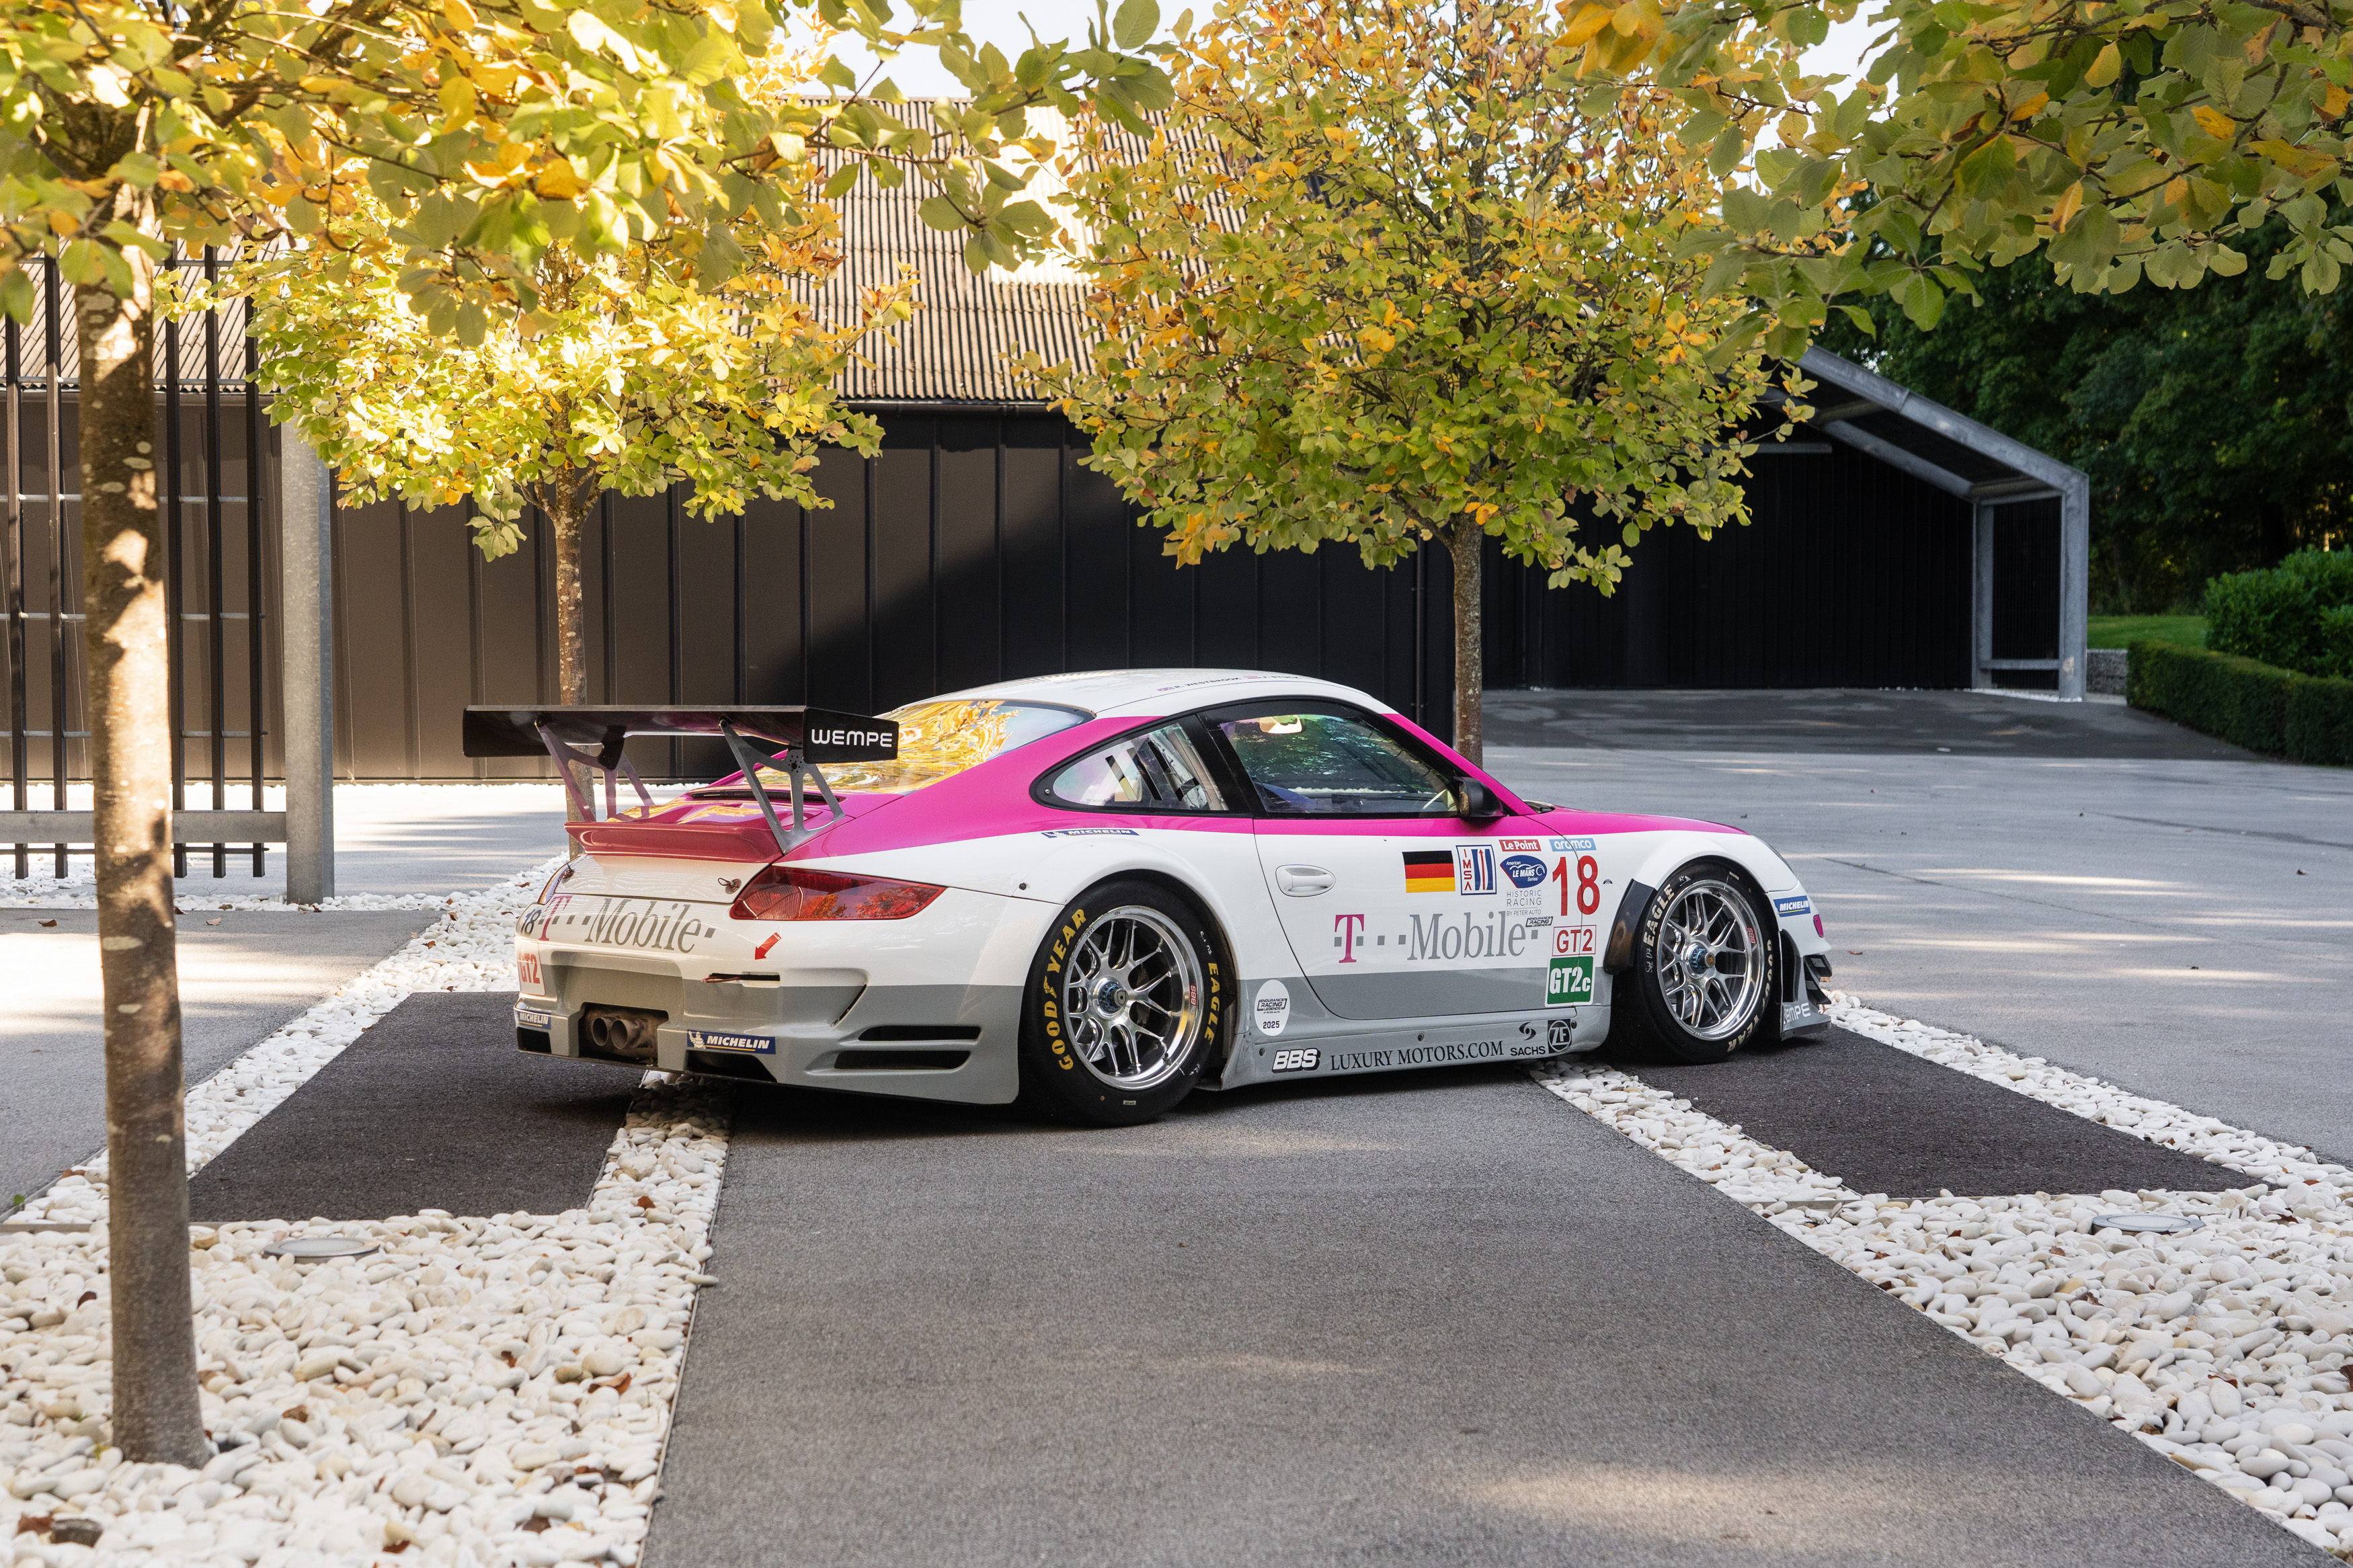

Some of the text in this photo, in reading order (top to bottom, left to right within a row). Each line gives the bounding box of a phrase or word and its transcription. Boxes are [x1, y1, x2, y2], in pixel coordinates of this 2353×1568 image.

[811, 729, 893, 747] WEMPE
[1503, 840, 1538, 850] Le Point
[1554, 839, 1591, 849] aramco
[1513, 868, 1535, 878] LE MANS
[1507, 890, 1542, 898] HISTORIC
[1552, 855, 1600, 916] 18
[1507, 897, 1542, 907] RACING
[1779, 899, 1809, 911] MICHELIN
[1643, 884, 1675, 947] EAGLE
[584, 898, 702, 954] Mobile
[1407, 911, 1526, 960] Mobile
[1556, 928, 1593, 953] GT2
[1747, 927, 1757, 944] BBS
[519, 952, 541, 984] GT2
[1549, 966, 1591, 994] GT2c
[1204, 962, 1220, 1045] EAGLE
[519, 1012, 549, 1025] MICHELIN
[1263, 1020, 1280, 1029] 2025
[707, 1035, 770, 1049] MICHELIN
[1550, 1026, 1568, 1046] ZF
[1272, 1048, 1321, 1073] BBS
[1330, 1040, 1505, 1071] LUXURY MOTORS.COM
[1510, 1046, 1546, 1057] SACHS
